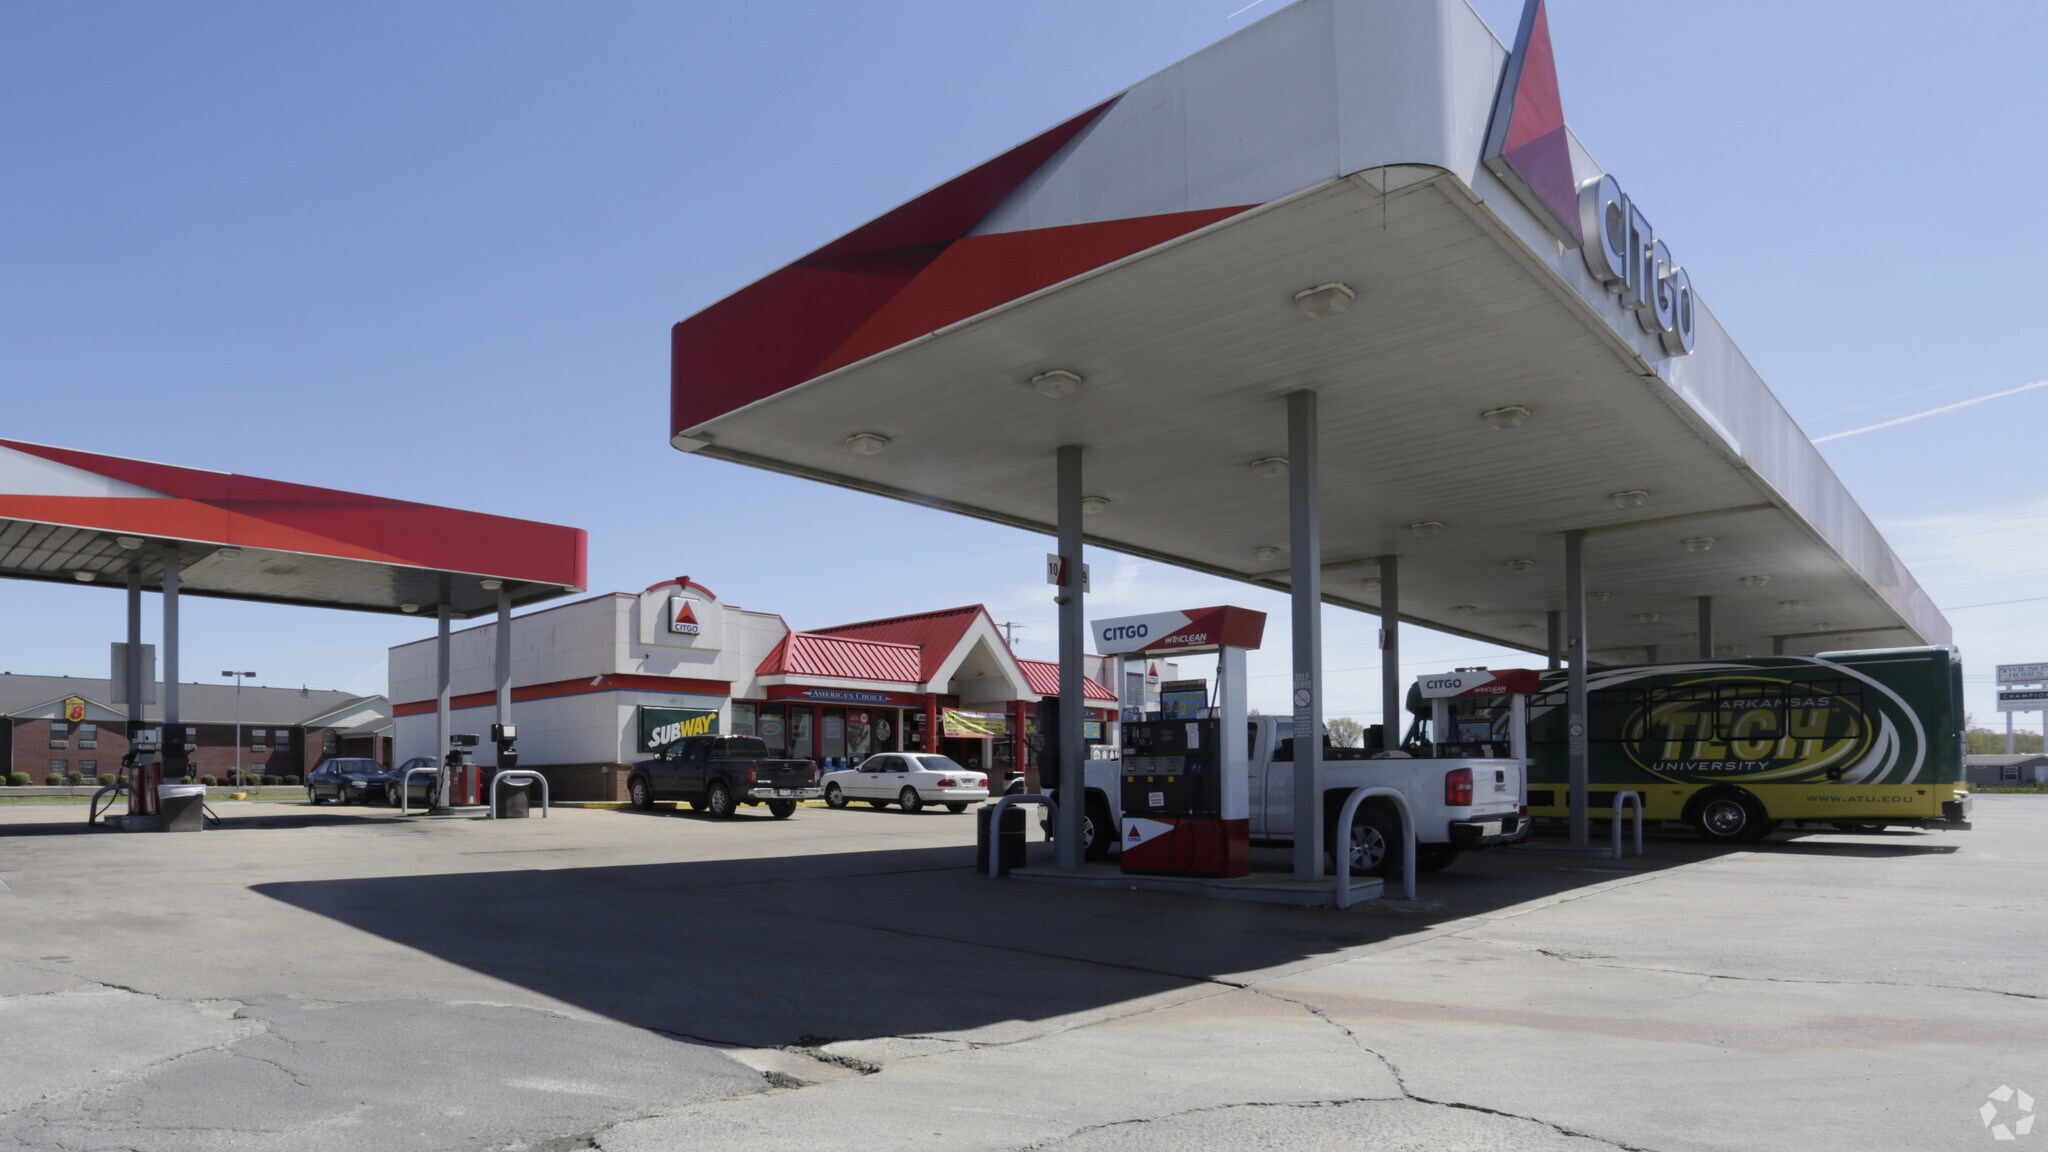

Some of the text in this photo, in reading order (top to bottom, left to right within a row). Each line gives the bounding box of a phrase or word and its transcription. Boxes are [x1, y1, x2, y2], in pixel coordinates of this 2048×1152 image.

[1581, 173, 1695, 356] CITGO
[1049, 562, 1059, 576] 10
[1082, 571, 1088, 584] 9
[674, 623, 699, 633] CITGO
[1103, 624, 1148, 641] CITGO
[1426, 679, 1462, 690] CITGO
[813, 690, 883, 700] AMERICA'S CHOICE
[1719, 697, 1831, 709] ARKANSAS
[648, 713, 717, 748] SUBWAY
[1650, 707, 1830, 761] TECH
[1652, 761, 1770, 771] UNIVERSITY
[1806, 795, 1913, 803] WWW.ATU.EDU
